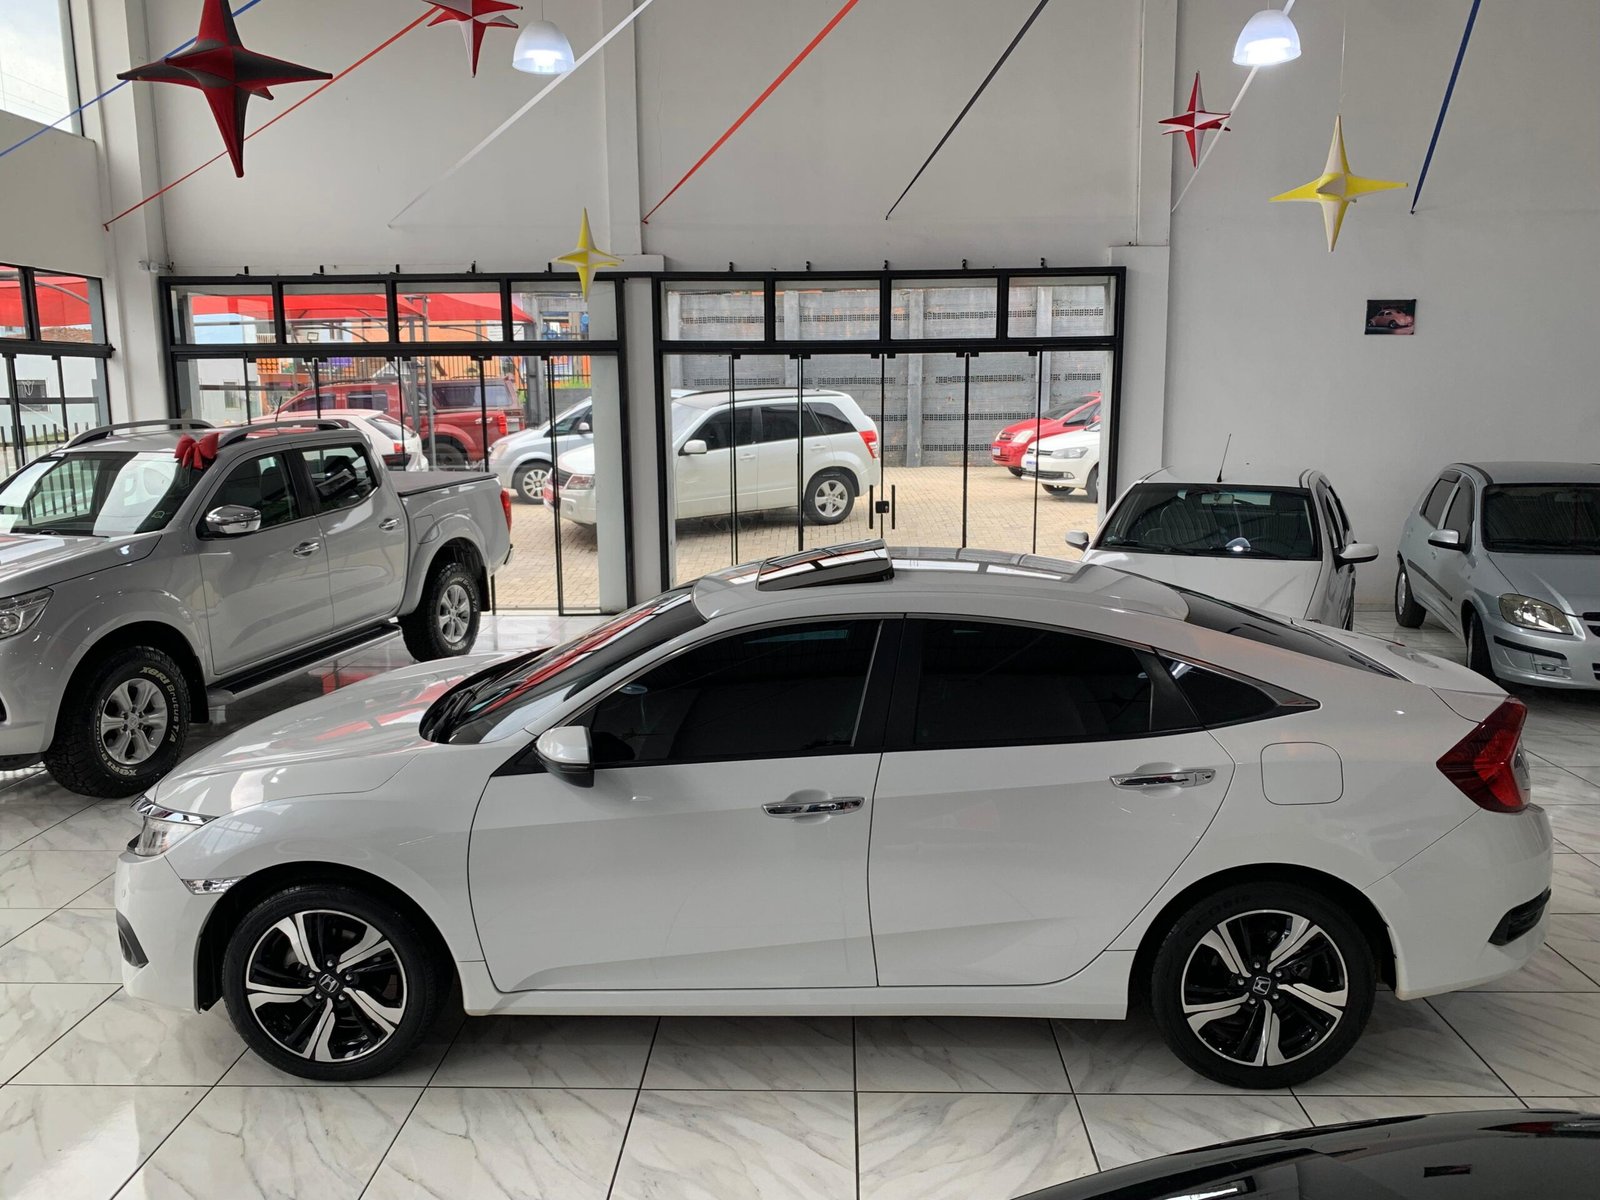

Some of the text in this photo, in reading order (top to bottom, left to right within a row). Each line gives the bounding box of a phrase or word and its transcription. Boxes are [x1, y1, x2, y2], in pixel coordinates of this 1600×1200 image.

[139, 666, 179, 742] XBRI Brutus T/A
